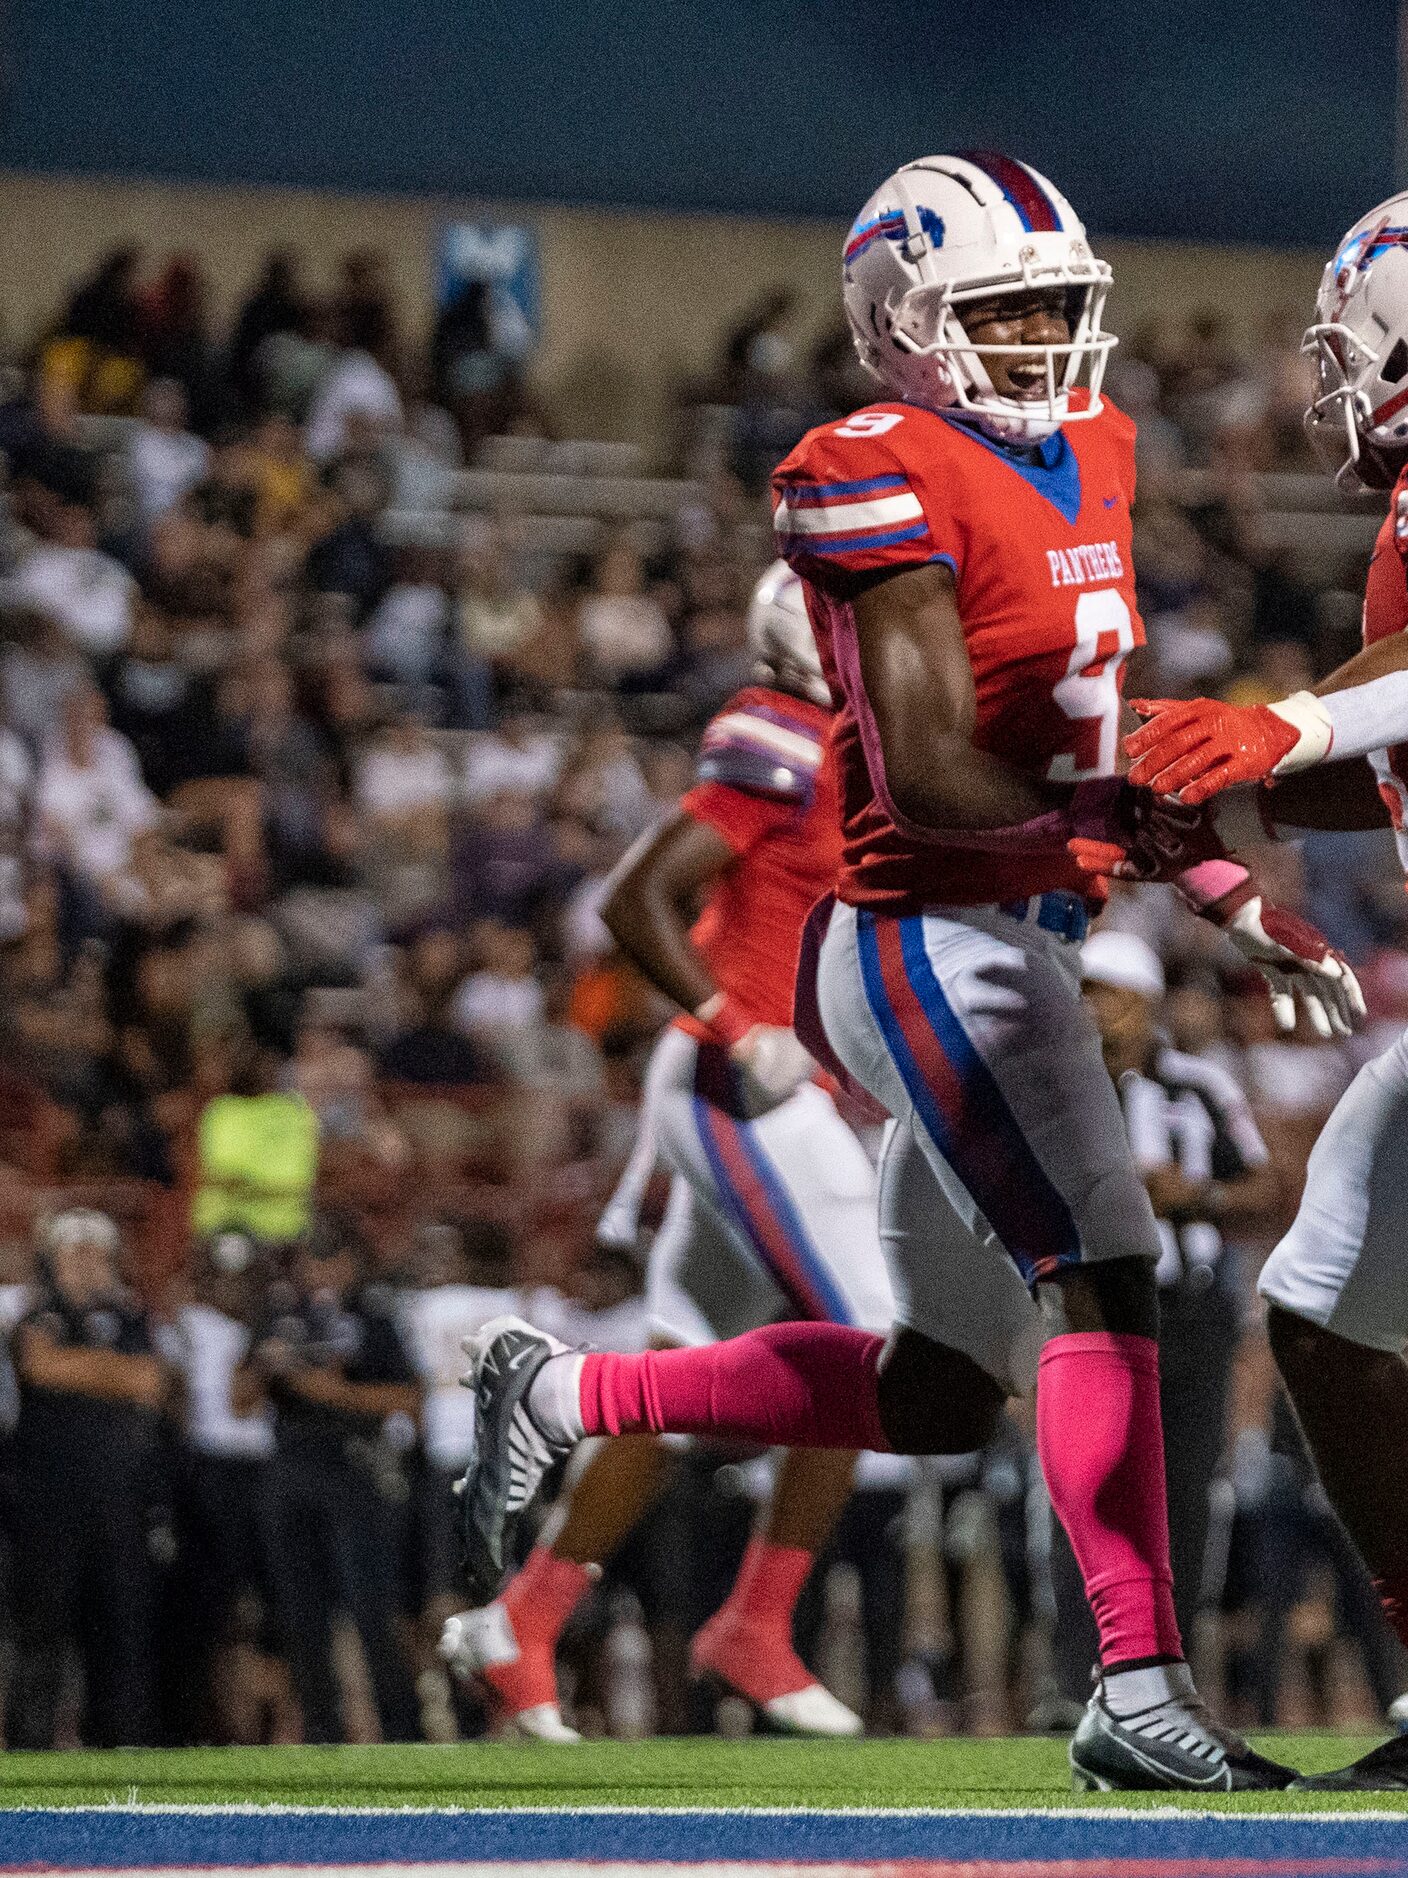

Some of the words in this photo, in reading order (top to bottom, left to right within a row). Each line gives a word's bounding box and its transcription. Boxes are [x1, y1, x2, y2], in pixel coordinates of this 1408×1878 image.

[833, 412, 905, 438] 9
[1046, 540, 1124, 588] PANTHERS
[1048, 588, 1135, 781] 9
